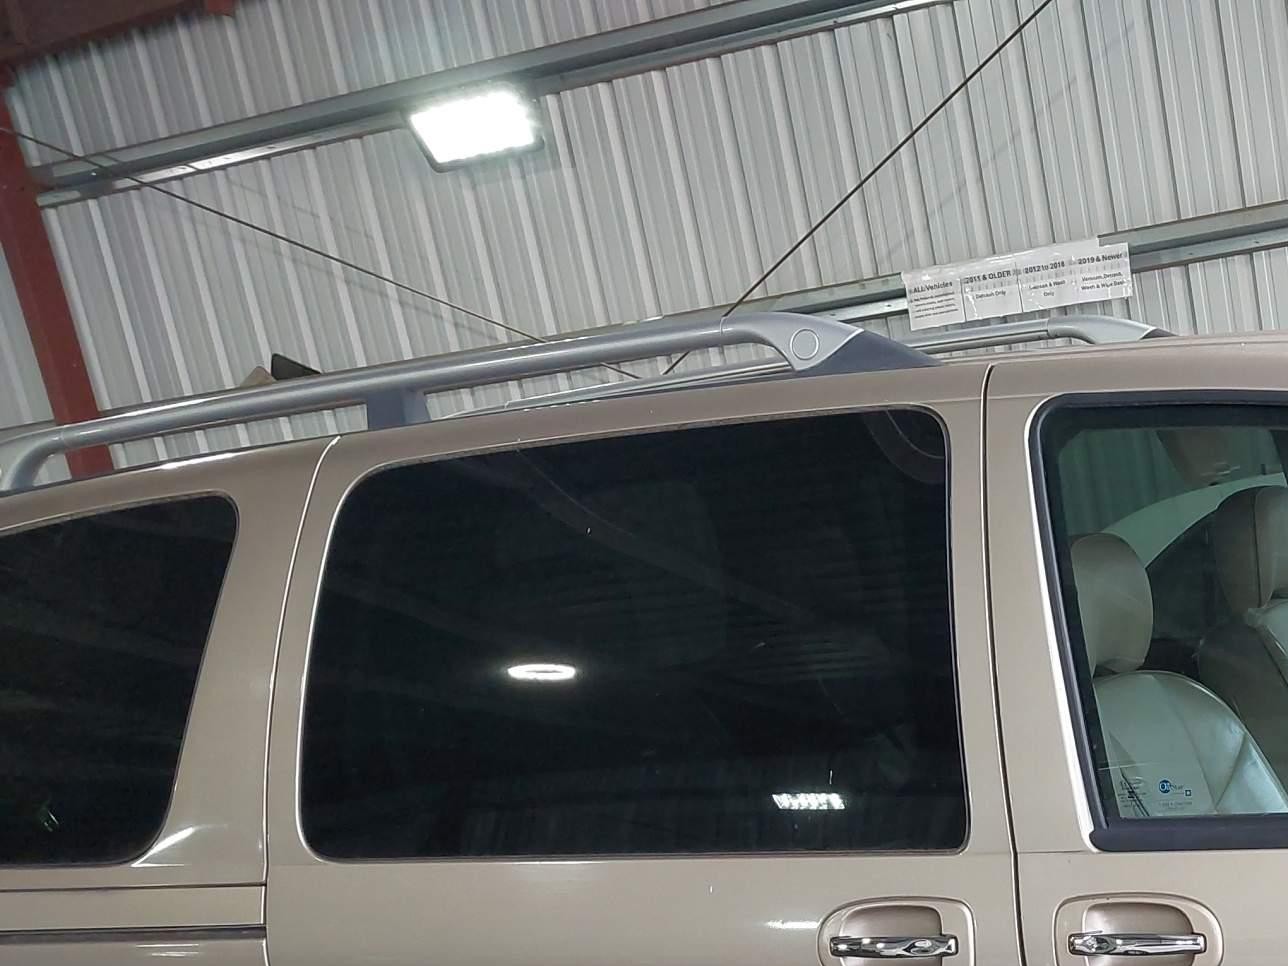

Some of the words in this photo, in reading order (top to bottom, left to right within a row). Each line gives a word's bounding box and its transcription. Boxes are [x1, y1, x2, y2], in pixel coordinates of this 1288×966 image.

[1077, 256, 1095, 264] 2019
[1102, 252, 1123, 262] Newer
[1024, 265, 1041, 274] 2012
[1050, 261, 1065, 270] 2018
[988, 270, 1011, 280] OLDER
[926, 281, 953, 291] Vehicles
